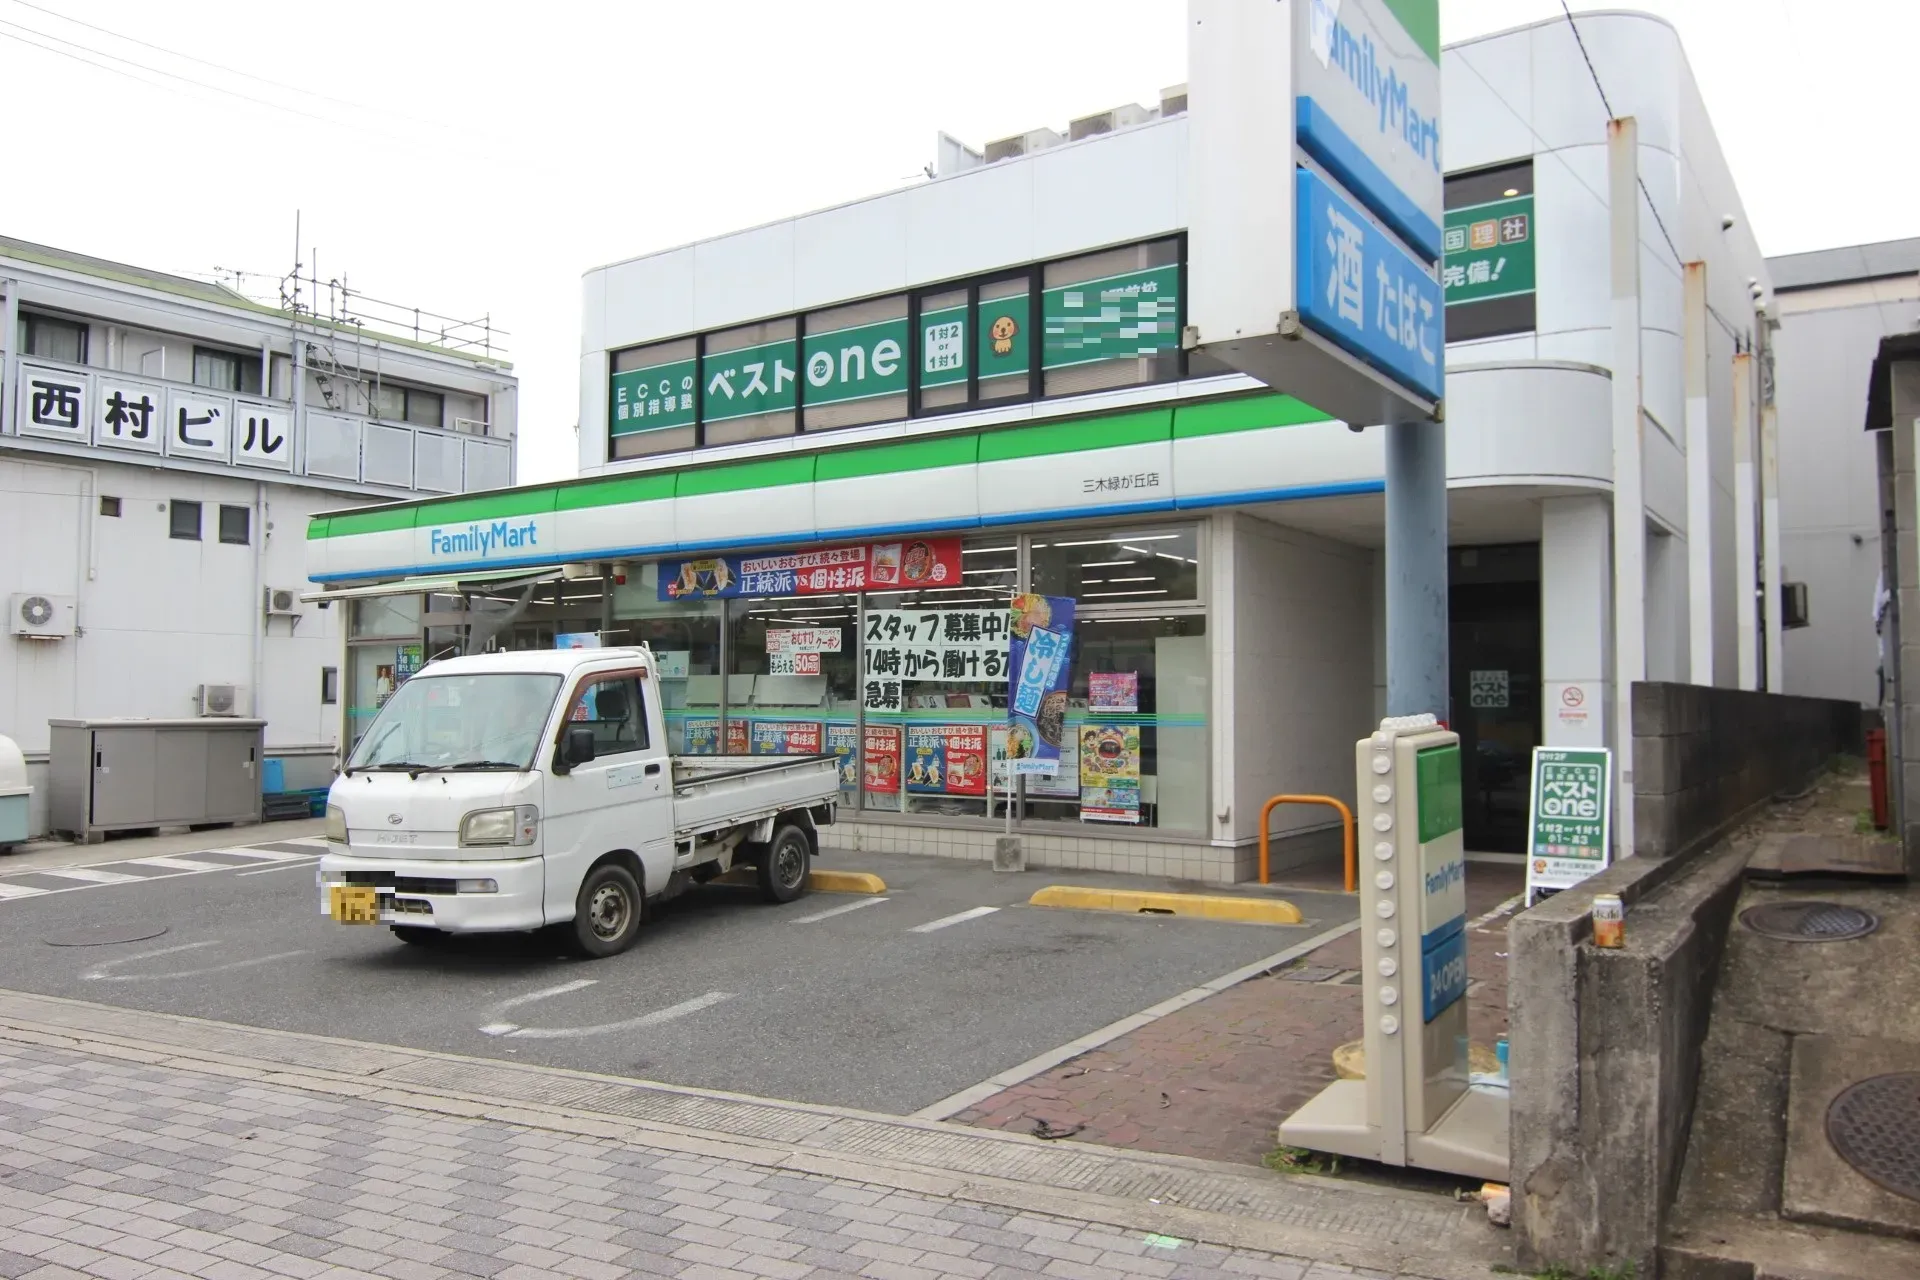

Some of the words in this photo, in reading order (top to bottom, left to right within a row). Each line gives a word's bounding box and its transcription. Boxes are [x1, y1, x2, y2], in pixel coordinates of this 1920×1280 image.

[1326, 203, 1364, 331] 酒
[1376, 258, 1436, 366] たばこ
[929, 325, 959, 342] 1対2
[938, 343, 949, 351] or
[707, 359, 796, 400] ベスト
[806, 339, 902, 387] one
[929, 353, 958, 369] 1対1
[32, 380, 284, 454] 西村ビル
[617, 393, 693, 421] 個別指導塾
[1082, 472, 1160, 493] 三木緑が丘店
[431, 519, 537, 557] FamilyMart
[816, 636, 841, 649] クーポン
[771, 659, 794, 674] もらえる
[864, 681, 900, 709] 急募
[1544, 781, 1597, 799] ベスト
[1543, 797, 1597, 816] one
